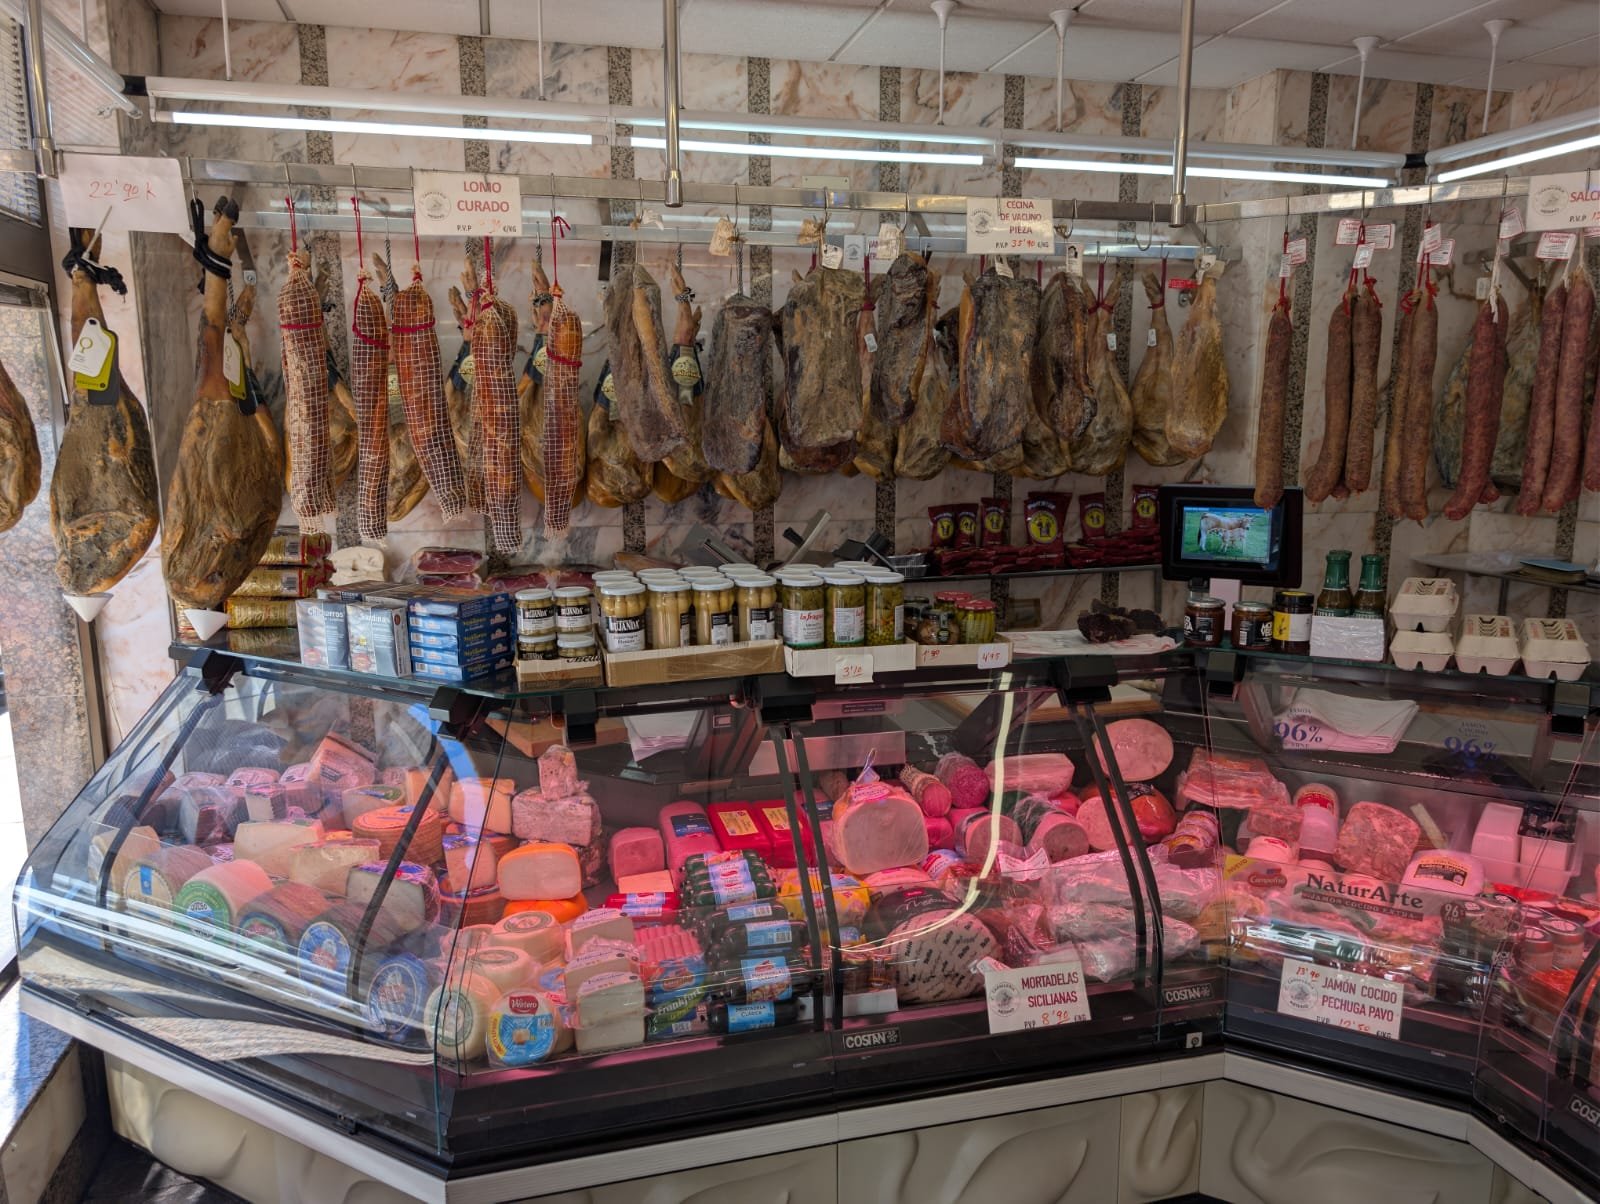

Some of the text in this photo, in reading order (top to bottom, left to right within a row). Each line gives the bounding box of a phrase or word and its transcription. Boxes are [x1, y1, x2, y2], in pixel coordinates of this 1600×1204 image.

[463, 181, 502, 193] LOMO
[457, 200, 510, 212] CURADO
[1006, 200, 1034, 209] CECINA
[1000, 213, 1042, 221] DE VACUNO
[1009, 226, 1033, 234] PIEZA
[1307, 873, 1424, 909] NaturArte
[1021, 972, 1079, 990] MORTADELAS
[1166, 986, 1201, 1003] COSTAN
[1322, 977, 1356, 995] JAMÓN
[1361, 985, 1398, 1004] COCIDO
[1028, 991, 1078, 1008] SICILIANAS
[1321, 995, 1394, 1022] PECHUGA PAVO
[845, 1031, 887, 1048] COSTAN
